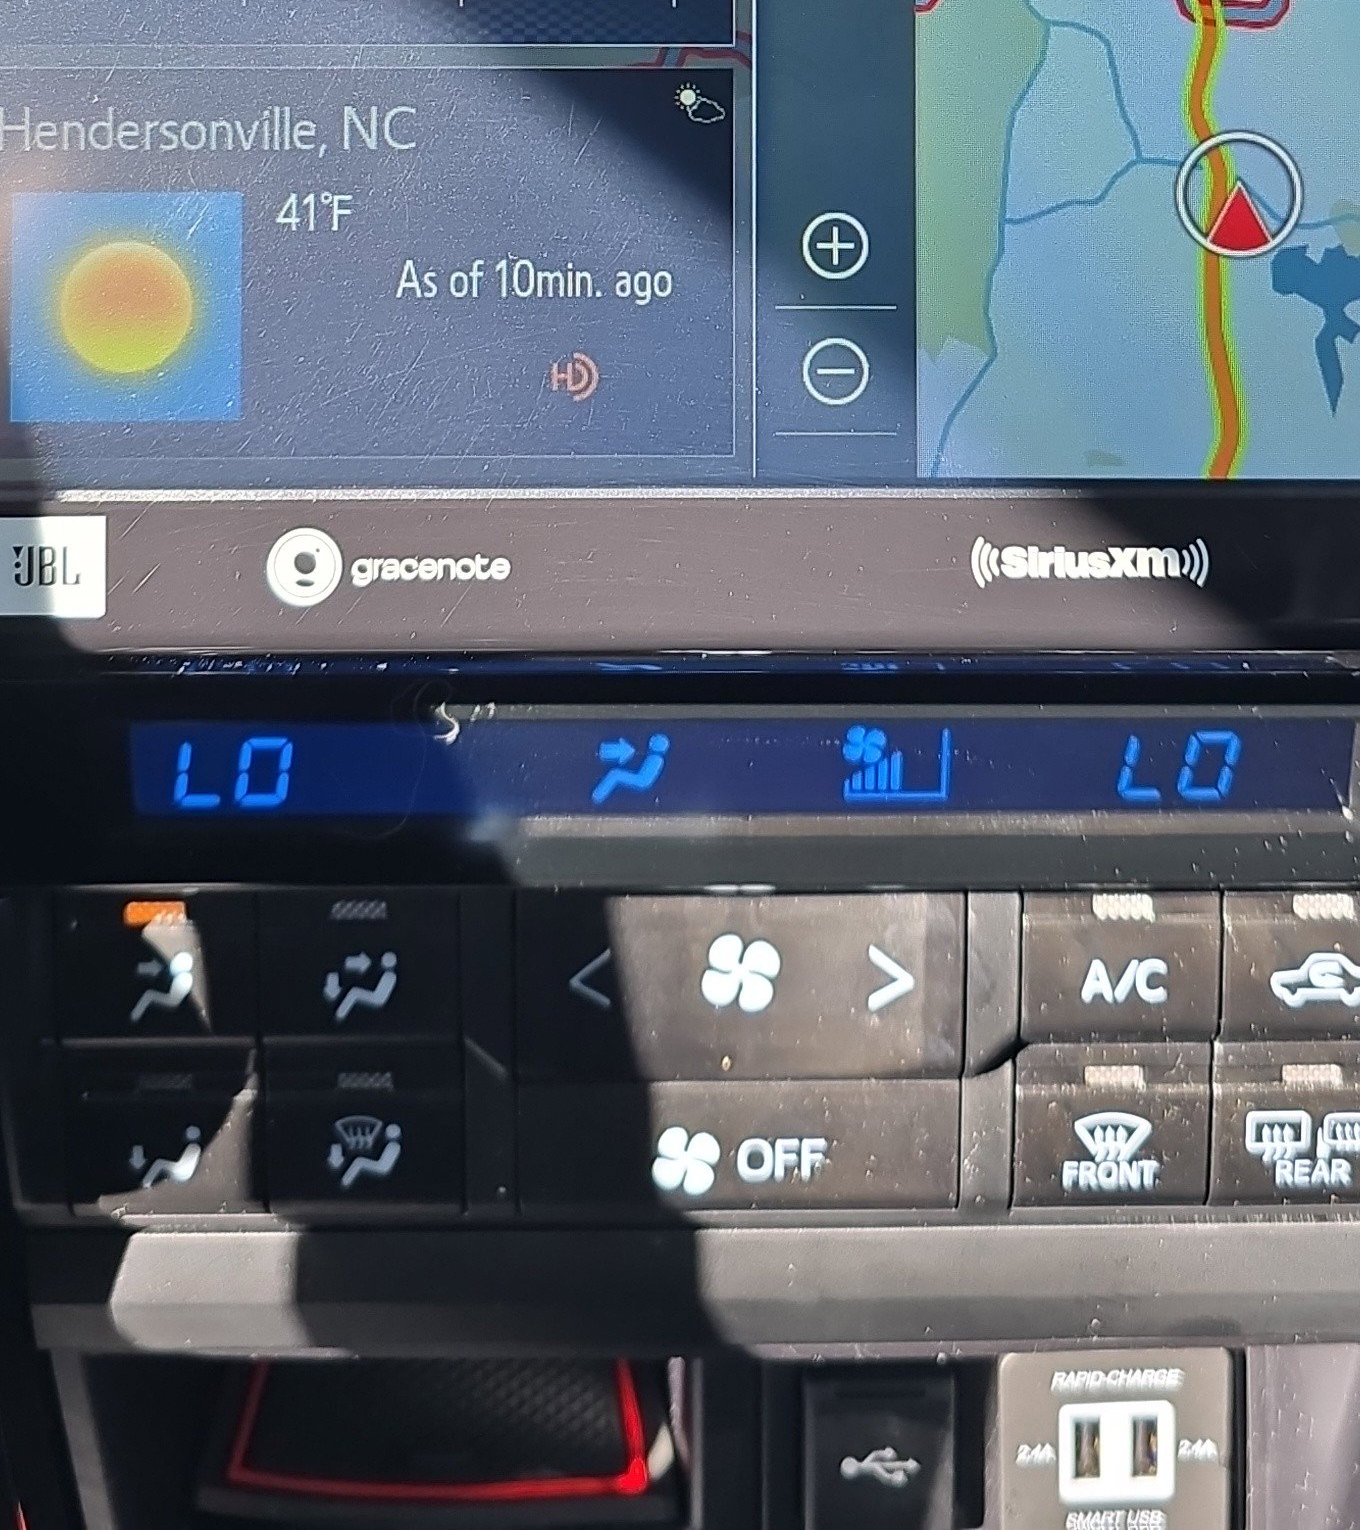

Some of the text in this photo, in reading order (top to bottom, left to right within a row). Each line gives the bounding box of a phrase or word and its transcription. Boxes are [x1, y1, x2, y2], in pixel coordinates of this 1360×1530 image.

[342, 105, 418, 151] NC
[395, 258, 673, 306] As of 10min. ago
[13, 545, 81, 587] JBL
[350, 553, 512, 587] gracenote
[1080, 958, 1169, 1004] A/C
[736, 1138, 827, 1182] OFF
[1061, 1159, 1161, 1190] FRONT
[1274, 1158, 1352, 1186] REAR
